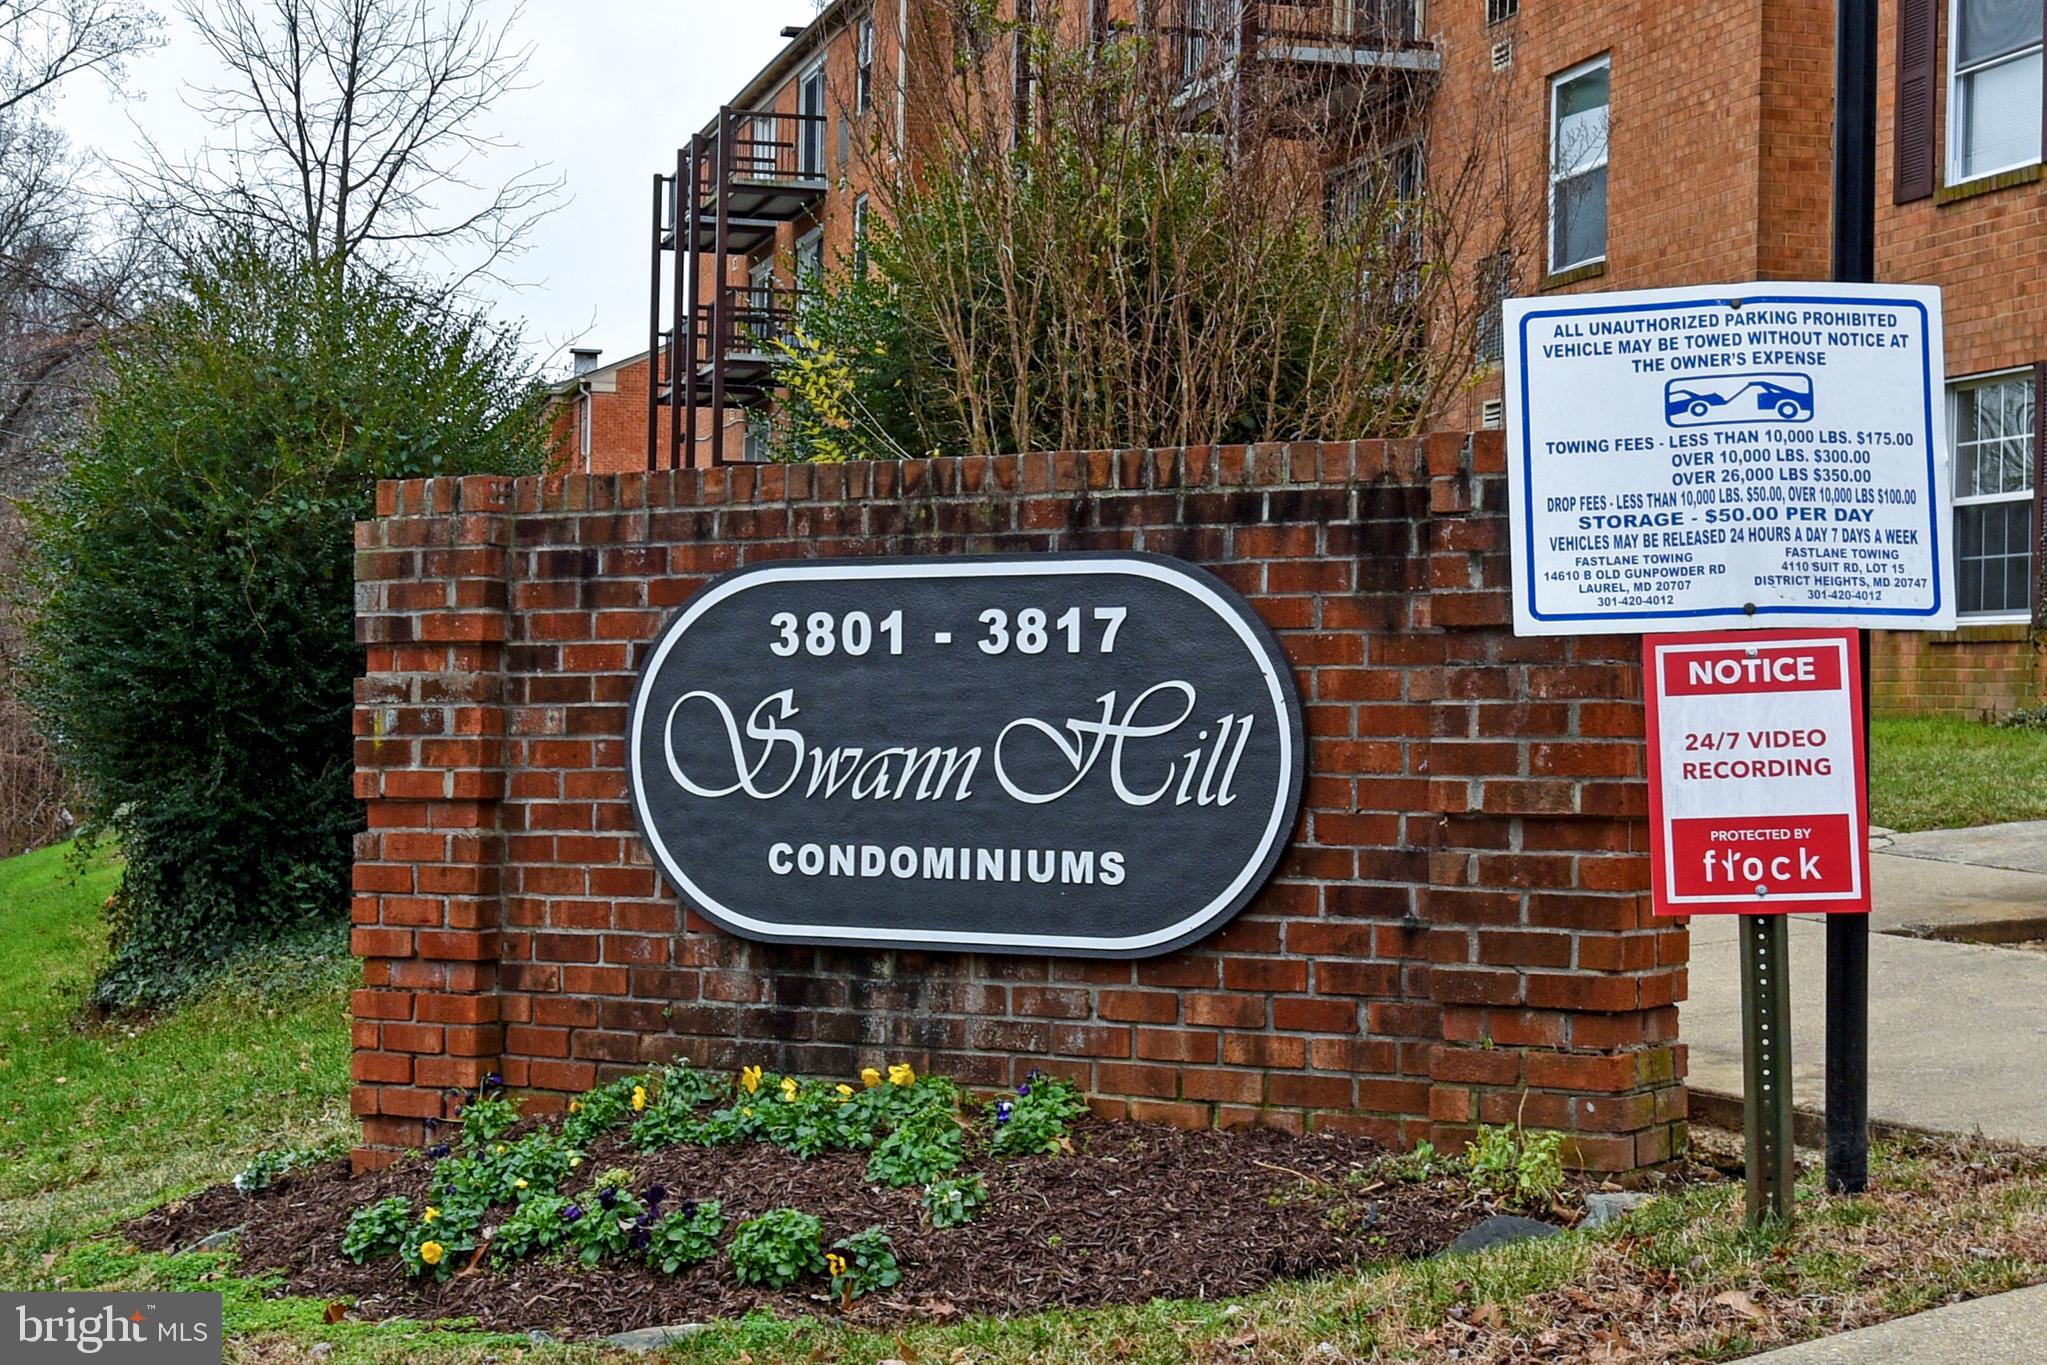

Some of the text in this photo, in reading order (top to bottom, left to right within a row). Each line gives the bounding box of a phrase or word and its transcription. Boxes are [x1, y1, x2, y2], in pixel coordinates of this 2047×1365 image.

[1554, 311, 1897, 338] ALL UNAUTHORIZED PARKING PROHIBITED
[1543, 331, 1908, 358] VEHICLE MAY BE TOWED WITHOUT NOTICE AT
[1632, 351, 1826, 373] THE OWNER'S EXPENSE
[1546, 440, 1609, 454] TOWING
[1615, 437, 1654, 451] FEES
[1670, 433, 1708, 448] LESS
[1714, 430, 1758, 444] THAN
[1765, 430, 1813, 445] 10,000
[1819, 431, 1851, 444] LBS.
[1857, 431, 1913, 446] $175.00
[1672, 449, 1870, 467] OVER 10,000 LBS. $300.00
[1672, 468, 1871, 486] OVER 26,000 LBS $350.00
[1548, 497, 1576, 512] DROP
[1580, 495, 1606, 511] FEES
[1617, 494, 1643, 509] LESS
[1647, 492, 1676, 507] THAN
[1681, 489, 1715, 508] 10,000
[1719, 488, 1743, 503] LBS.
[1747, 486, 1785, 504] $50.00,
[1788, 486, 1816, 501] OVER
[1820, 487, 1852, 505] 10,000
[1856, 488, 1874, 503] LBS
[1878, 488, 1916, 504] $100.00
[1579, 512, 1684, 529] STORAGE
[1705, 507, 1778, 524] $50.00
[1786, 507, 1827, 521] PER
[1835, 508, 1873, 522] DAY
[1550, 527, 1918, 551] VEHICLES MAY BE RELEASED 24 HOURS A DAY 7 DAYS A WEEK
[1576, 553, 1692, 566] FASTLANE TOWING
[1786, 547, 1899, 559] FASTLANE TOWING
[1544, 564, 1725, 581] 14610 B OLD GUNPOWDER RD
[1782, 561, 1904, 574] 4110 SUIT RD, LOT 15
[1579, 580, 1691, 593] LAUREL, MD 20707
[1755, 575, 1927, 588] DISTRICT HEIGHTS, MD 20747
[1598, 595, 1673, 606] 301-420-4012
[1808, 590, 1881, 600] 301-420-4012
[770, 610, 902, 656] 3801
[978, 607, 1126, 654] 3817
[1689, 657, 1815, 684] NOTICE
[665, 680, 1253, 806] Swann Hill
[1685, 729, 1826, 751] 24/7 VIDEO
[1683, 758, 1831, 779] RECORDING
[1711, 828, 1811, 841] PROTECTED BY
[769, 843, 1125, 885] CONDOMINIUMS
